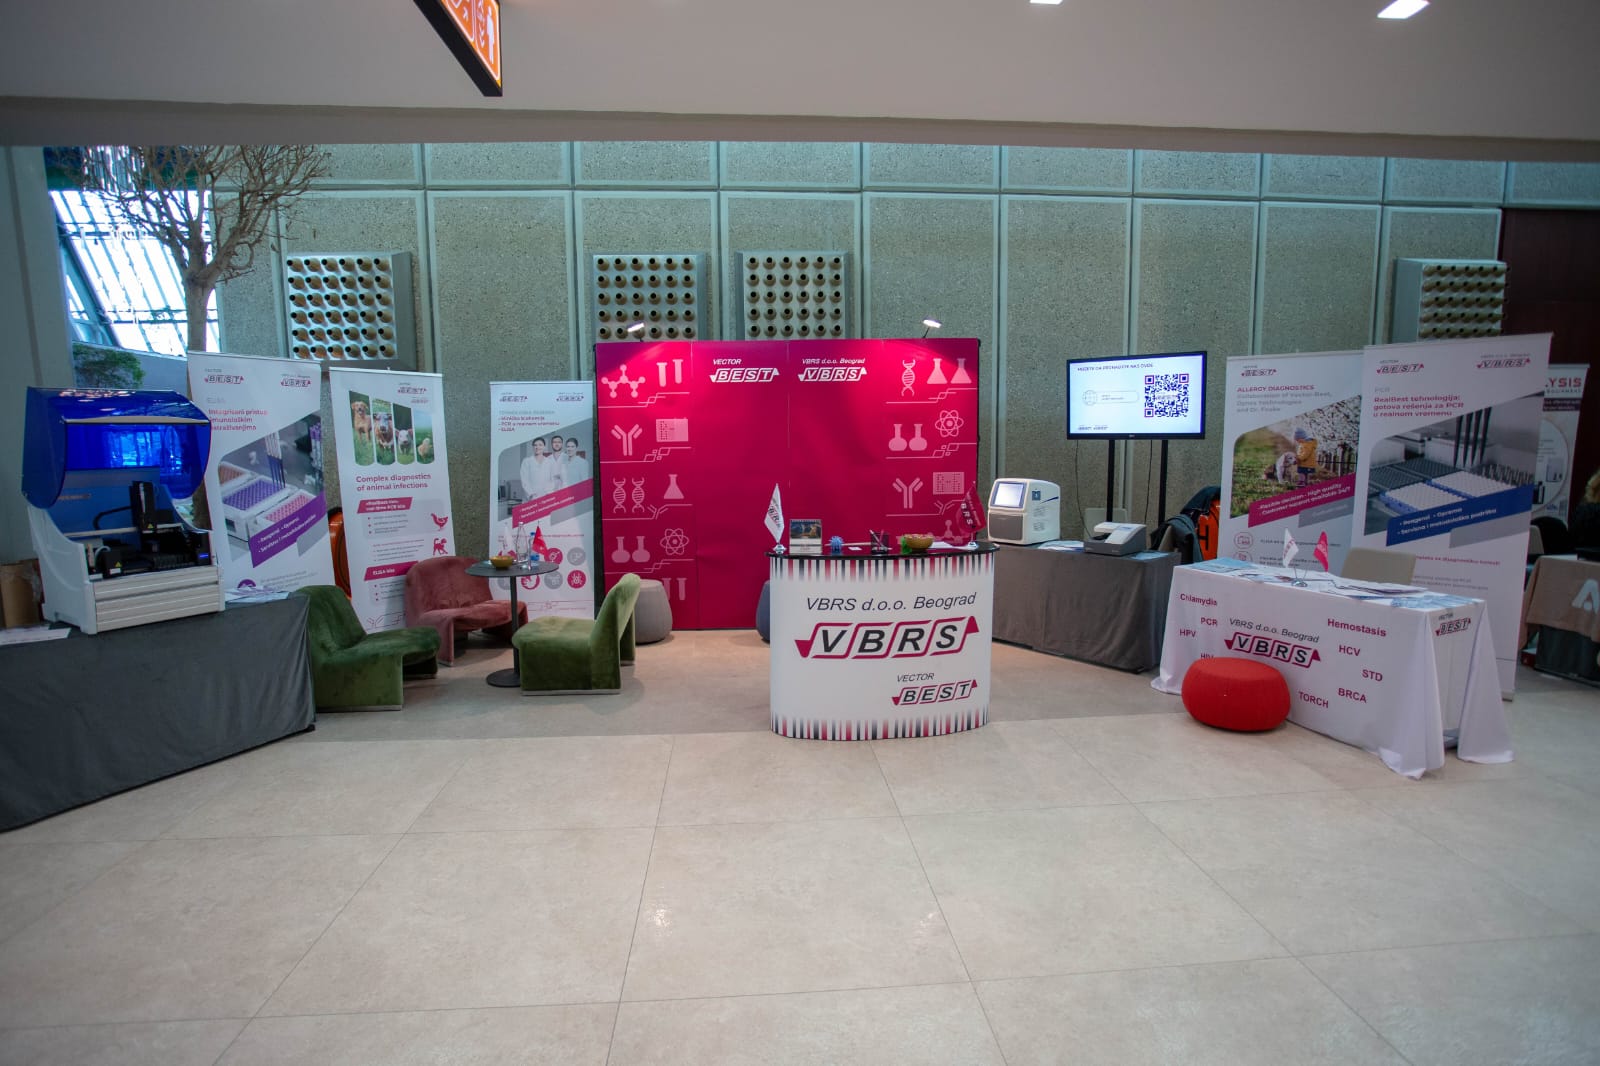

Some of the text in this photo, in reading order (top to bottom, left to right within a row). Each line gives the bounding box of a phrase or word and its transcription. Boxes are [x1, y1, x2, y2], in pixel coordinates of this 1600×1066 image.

[712, 358, 742, 366] VECTOR
[839, 357, 865, 366] Beograd
[805, 368, 859, 380] VBRS
[1381, 363, 1420, 374] BEST
[208, 374, 242, 384] BEST
[716, 369, 773, 381] BEST
[1374, 395, 1408, 403] RealBest
[1373, 402, 1401, 411] gotova
[1403, 402, 1432, 410] rešenja
[356, 472, 431, 484] Complex diagnostics
[366, 483, 392, 491] animal
[393, 482, 428, 490] infections
[806, 591, 977, 611] VBRS d.o.o. Beograd
[1179, 593, 1218, 607] Chlamydia
[1200, 616, 1218, 627] PCR
[1327, 618, 1387, 637] Hemostasis
[1179, 628, 1196, 638] HPV
[1229, 617, 1320, 644] VBRS d.o.o. Beograd
[818, 623, 960, 654] VBRS
[1236, 635, 1309, 665] VBRS
[1338, 644, 1361, 657] HCV
[896, 672, 935, 683] VECTOR
[1362, 669, 1383, 682] STD
[900, 682, 971, 704] BEST
[1338, 687, 1367, 703] BRCA
[1298, 691, 1329, 708] TORCH
